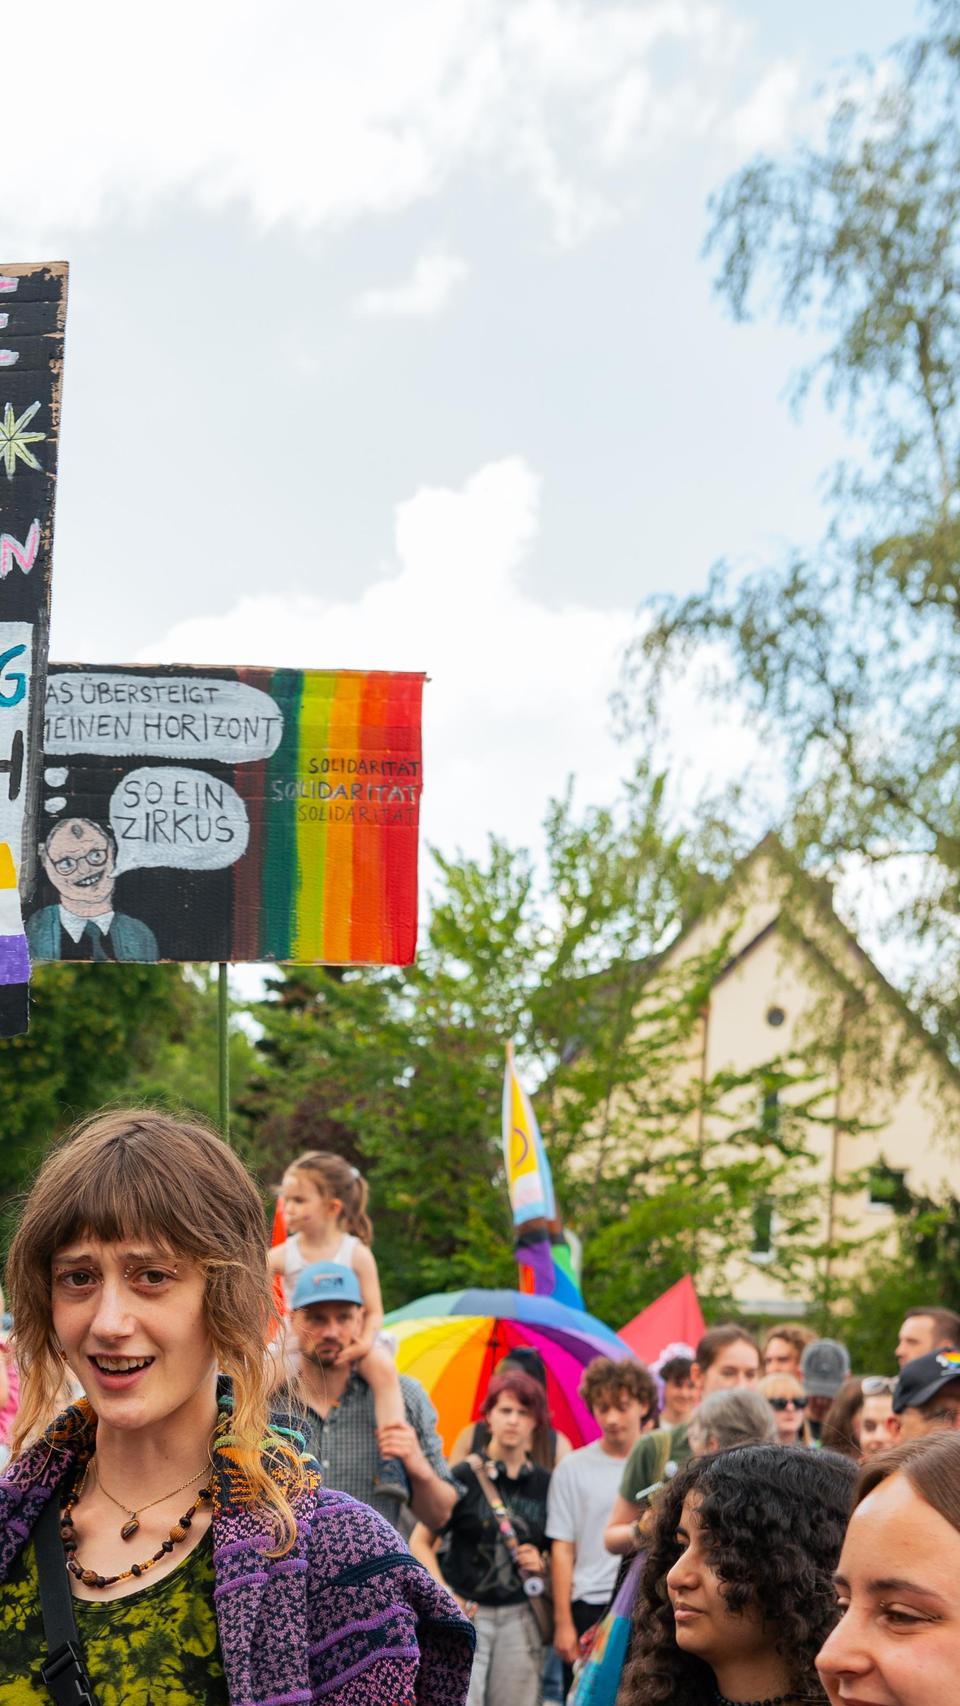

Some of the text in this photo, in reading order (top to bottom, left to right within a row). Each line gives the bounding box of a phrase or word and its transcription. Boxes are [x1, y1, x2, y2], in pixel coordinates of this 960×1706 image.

[44, 677, 220, 706] AS ÜBERSTEIGT
[143, 713, 283, 745] HORIZONT
[308, 757, 420, 777] SOLIDARITÄT
[123, 780, 224, 810] SO EIN
[270, 779, 419, 805] SOLIDARITÄT
[113, 809, 235, 844] ZIRKUS
